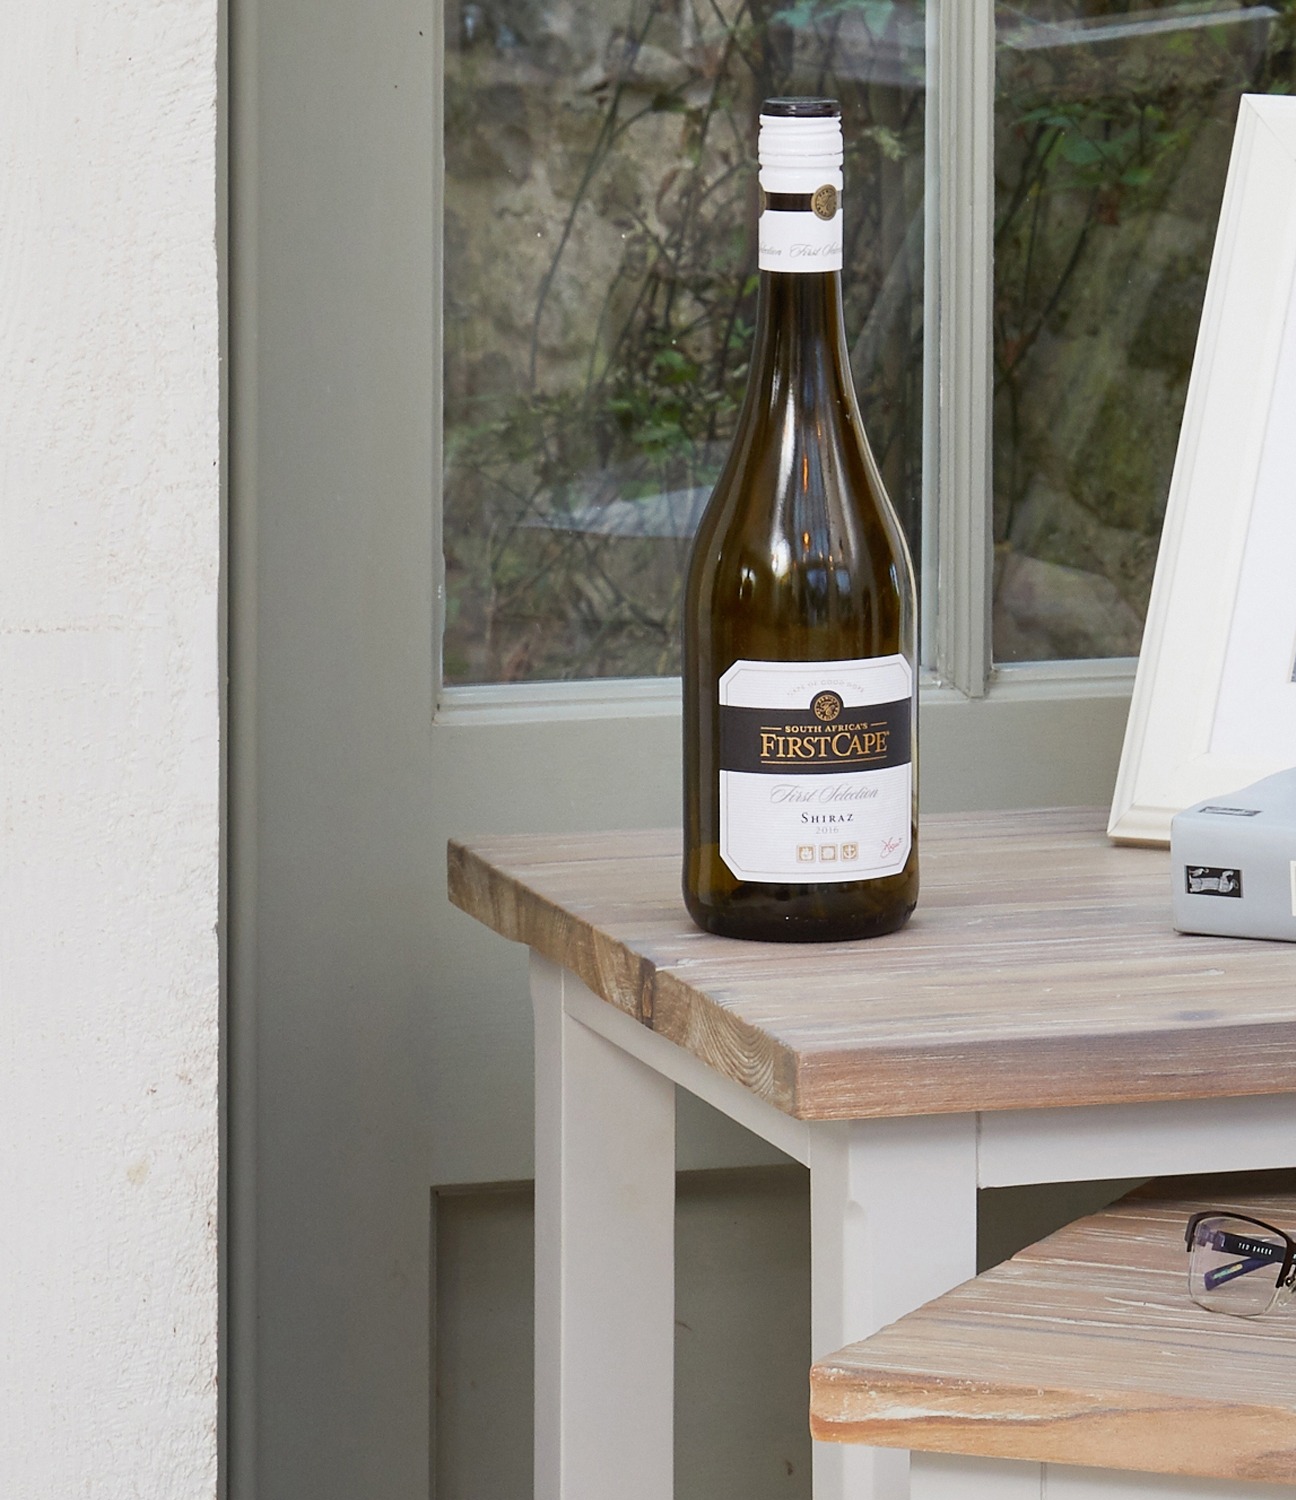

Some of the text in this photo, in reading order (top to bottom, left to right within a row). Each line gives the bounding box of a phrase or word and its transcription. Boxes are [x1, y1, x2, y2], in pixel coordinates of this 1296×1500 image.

[784, 722, 868, 733] SOUTH AFRICA'S
[770, 783, 879, 804] First Selection
[801, 812, 854, 823] SHIRAZ
[816, 826, 840, 834] 2016
[1238, 1242, 1250, 1251] TED
[1252, 1245, 1273, 1255] BAKER
